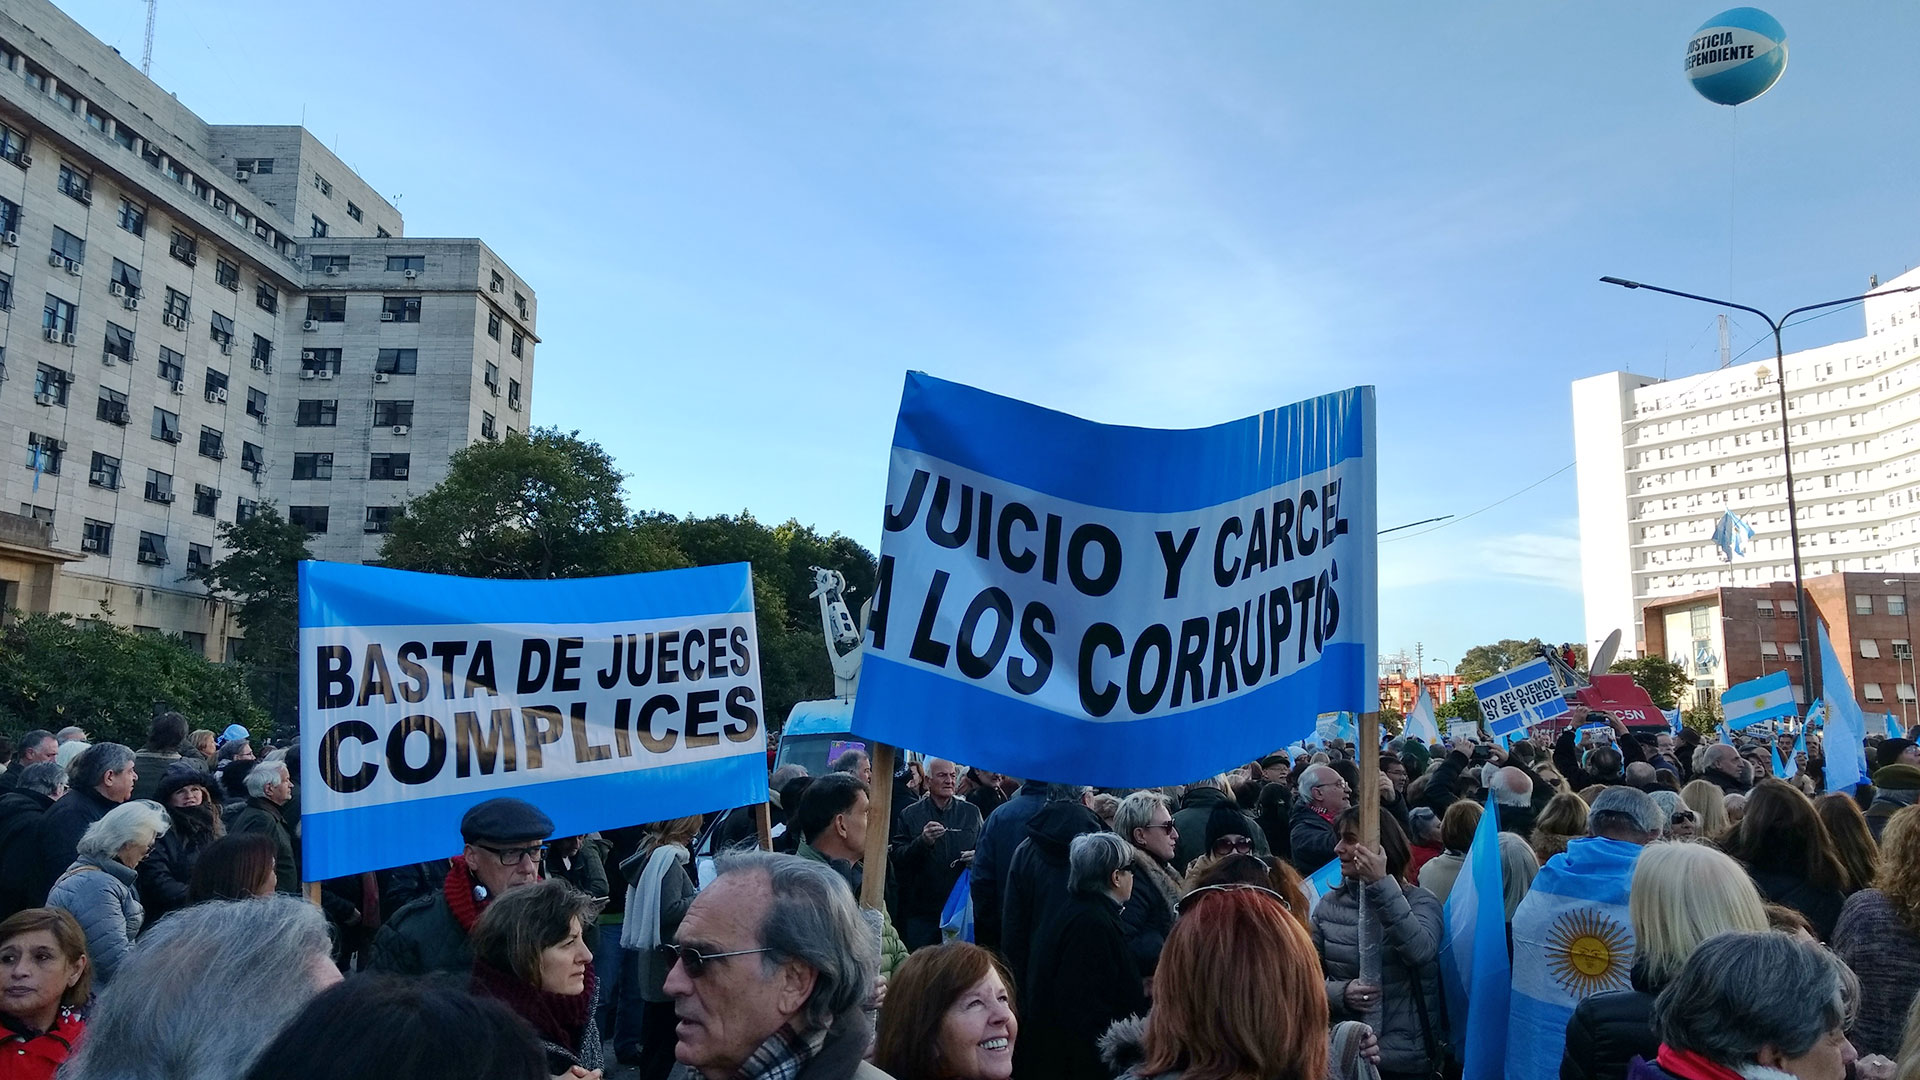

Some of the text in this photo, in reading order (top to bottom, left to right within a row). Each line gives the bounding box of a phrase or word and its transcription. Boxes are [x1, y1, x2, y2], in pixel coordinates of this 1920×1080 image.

[885, 468, 1348, 600] JUICIO Y CARCEL
[317, 626, 751, 710] BASTA DE JUECES
[909, 570, 1056, 696] LOS
[1482, 676, 1556, 712] NO AFLOJEMOS
[1501, 701, 1519, 715] SE
[1520, 686, 1560, 709] PUEDE
[1614, 709, 1646, 721] C5N
[318, 686, 758, 794] COMPLICES
